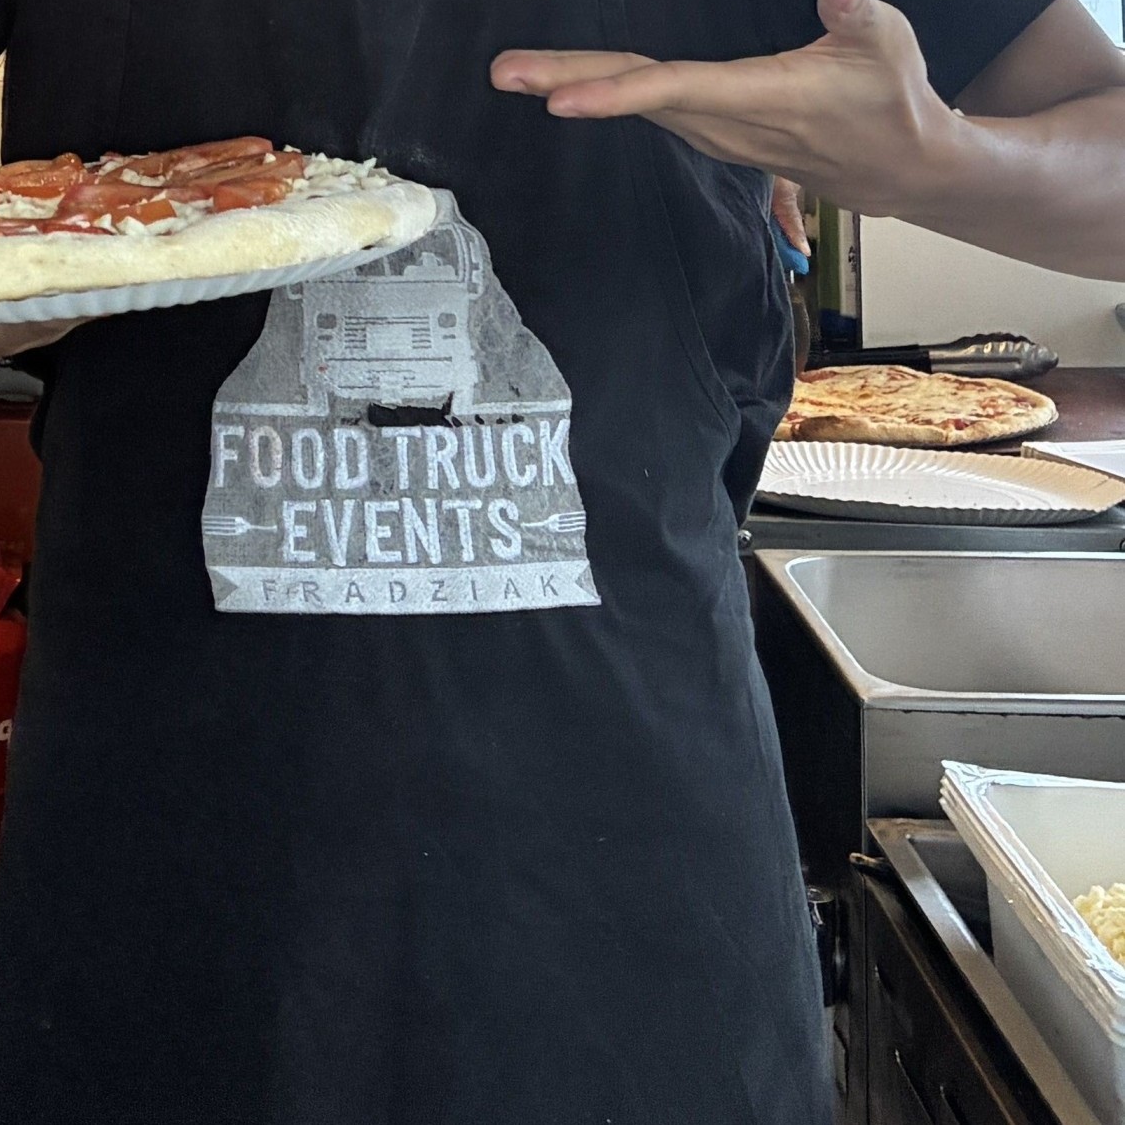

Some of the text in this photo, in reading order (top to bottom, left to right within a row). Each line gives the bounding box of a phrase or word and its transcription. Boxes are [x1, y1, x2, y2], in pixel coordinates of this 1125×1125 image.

[213, 420, 576, 492] FOOD TRUCK
[281, 497, 524, 567] EVENTS
[261, 575, 561, 604] FRADZIAK
